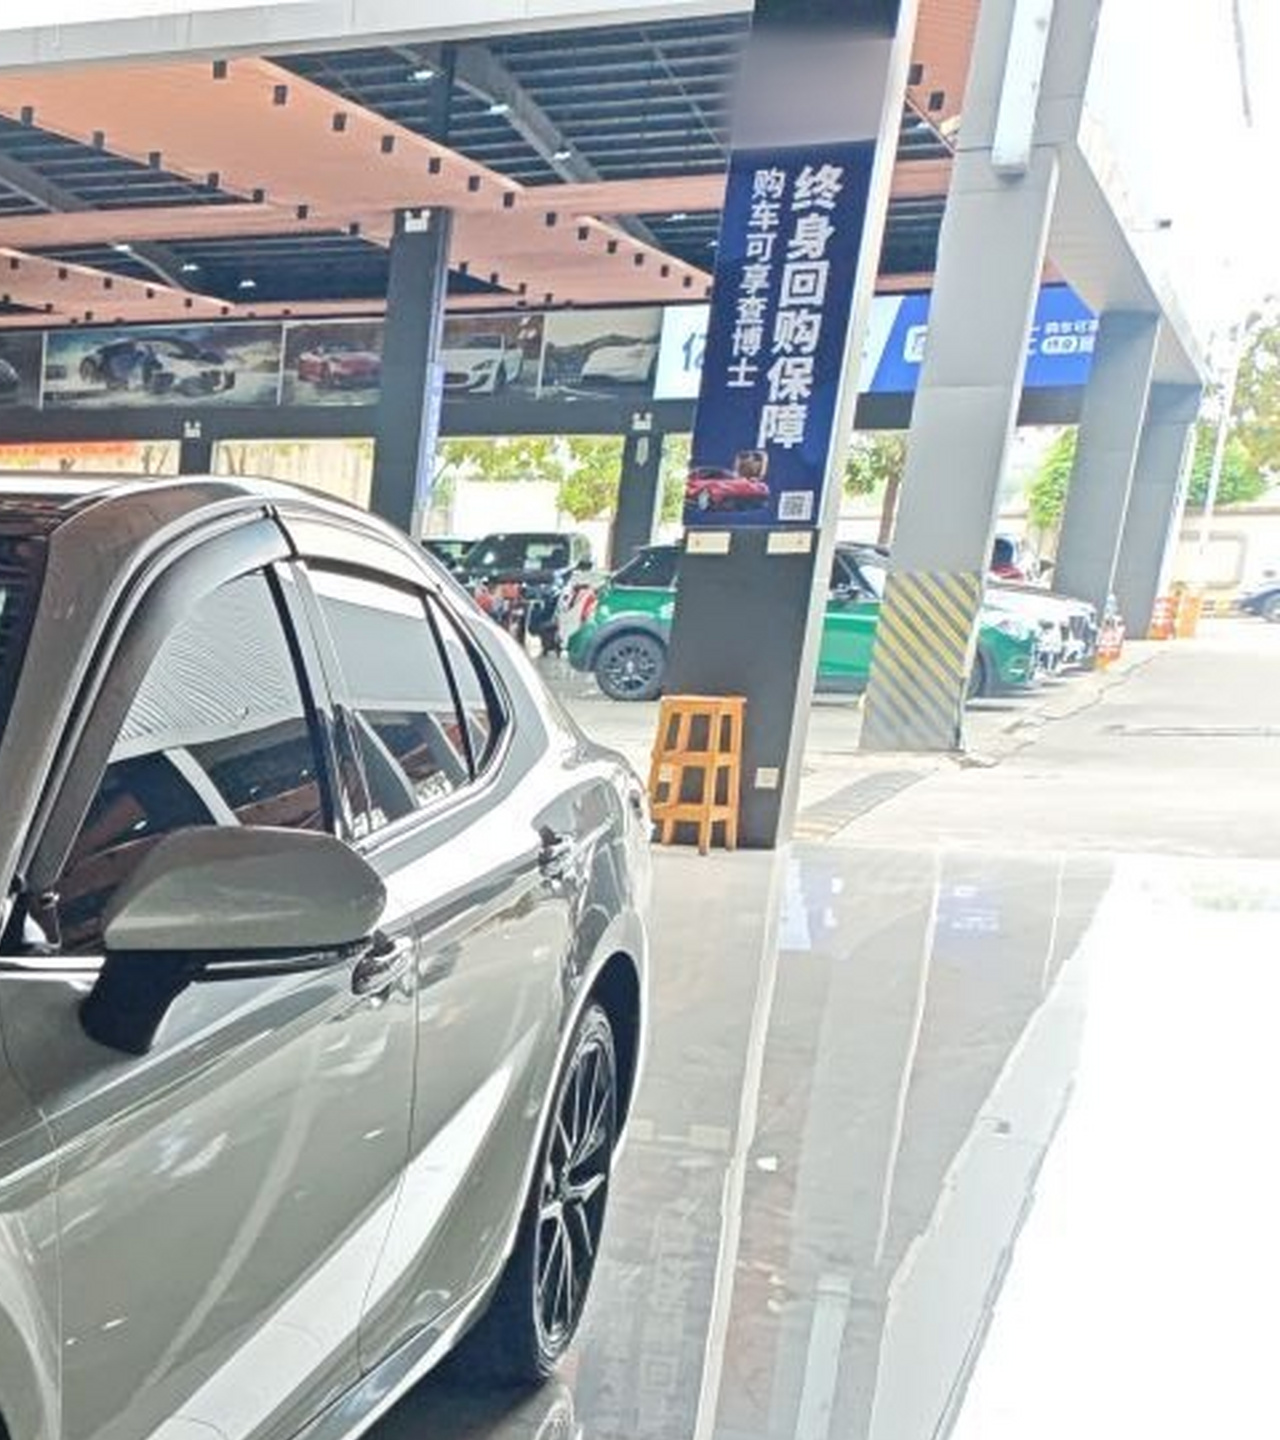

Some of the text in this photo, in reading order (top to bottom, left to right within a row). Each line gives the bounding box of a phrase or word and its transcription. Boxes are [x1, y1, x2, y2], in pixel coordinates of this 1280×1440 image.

[726, 167, 786, 389] 购车可享查博士
[756, 163, 844, 450] 终身回购保障
